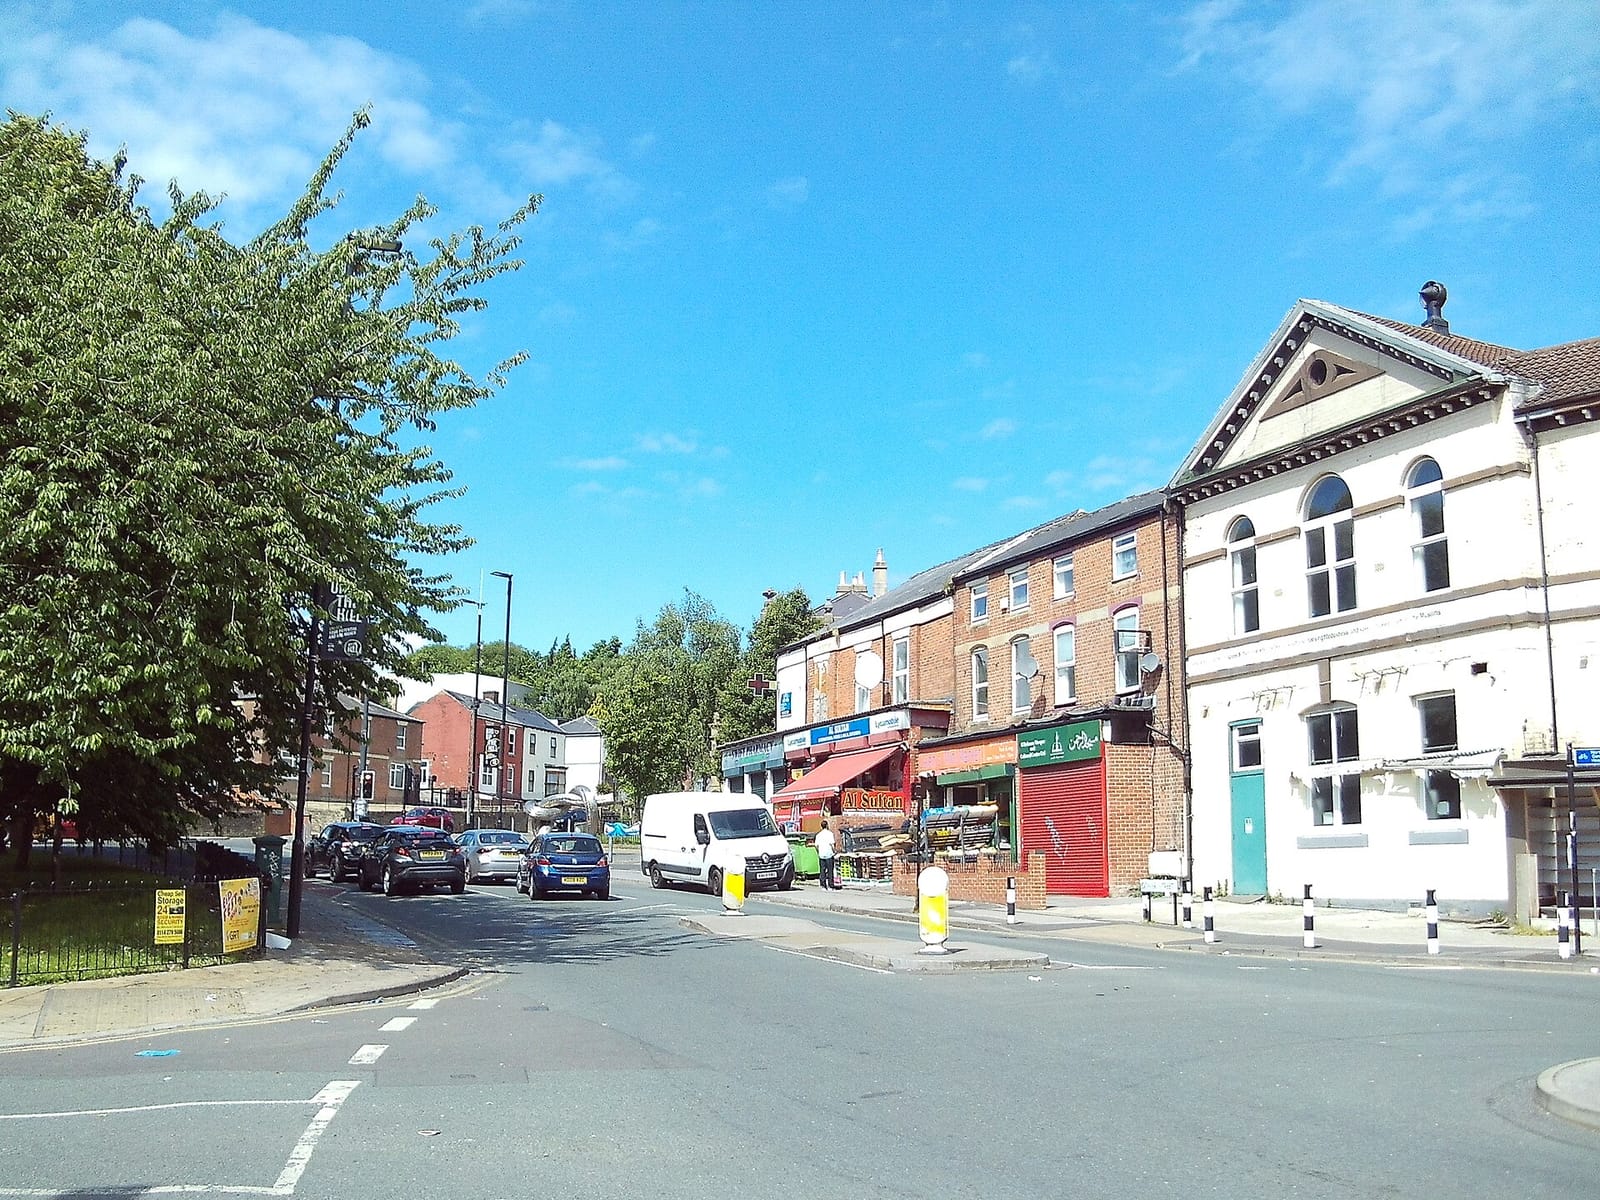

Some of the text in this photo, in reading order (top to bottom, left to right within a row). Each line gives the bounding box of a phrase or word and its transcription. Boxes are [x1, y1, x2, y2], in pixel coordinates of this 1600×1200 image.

[843, 790, 903, 810] Al Sultan
[157, 890, 174, 898] Cheap
[157, 896, 184, 906] Storage
[157, 905, 168, 915] 24
